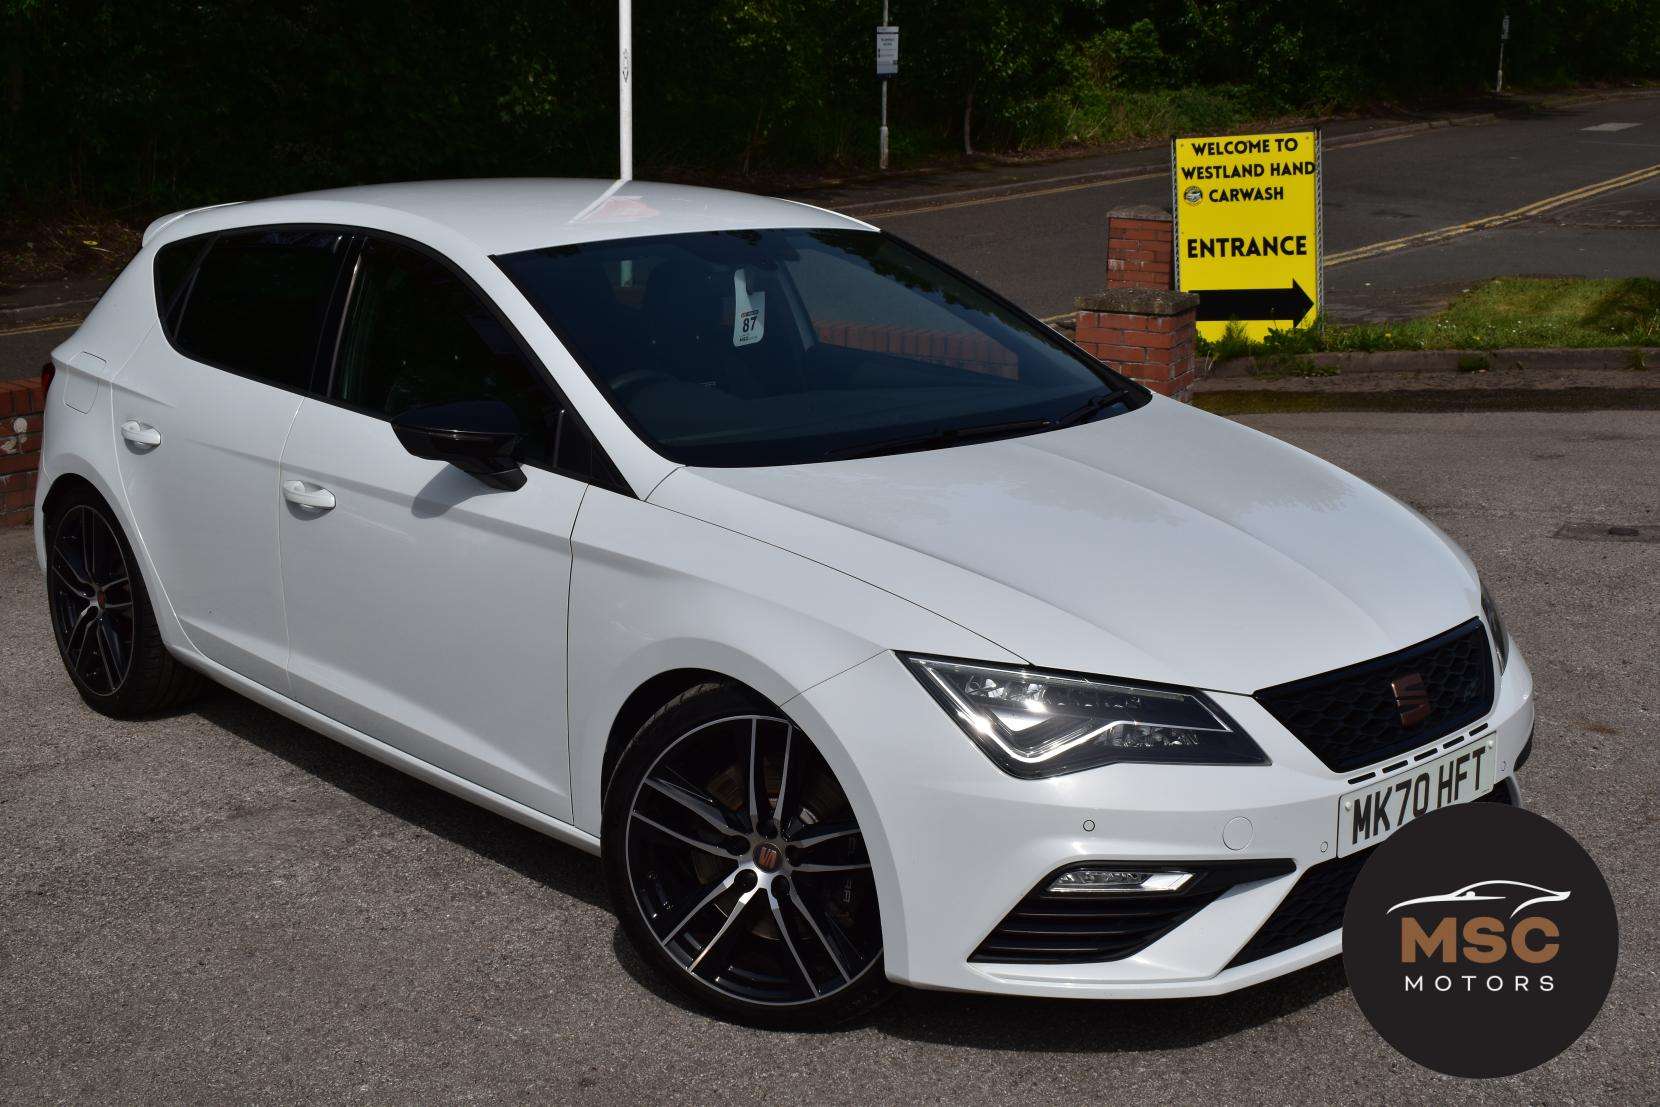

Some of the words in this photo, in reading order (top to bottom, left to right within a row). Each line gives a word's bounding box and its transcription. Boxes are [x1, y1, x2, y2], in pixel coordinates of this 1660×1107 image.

[1192, 139, 1270, 156] WELCOME
[1275, 138, 1298, 152] TO
[1181, 163, 1265, 180] WESTLAND
[1270, 162, 1315, 176] HAND
[1209, 187, 1284, 202] CARWASH
[1187, 236, 1307, 258] ENTRANCE
[743, 316, 757, 332] 87
[1352, 773, 1430, 844] MK70
[1437, 746, 1485, 808] HFT
